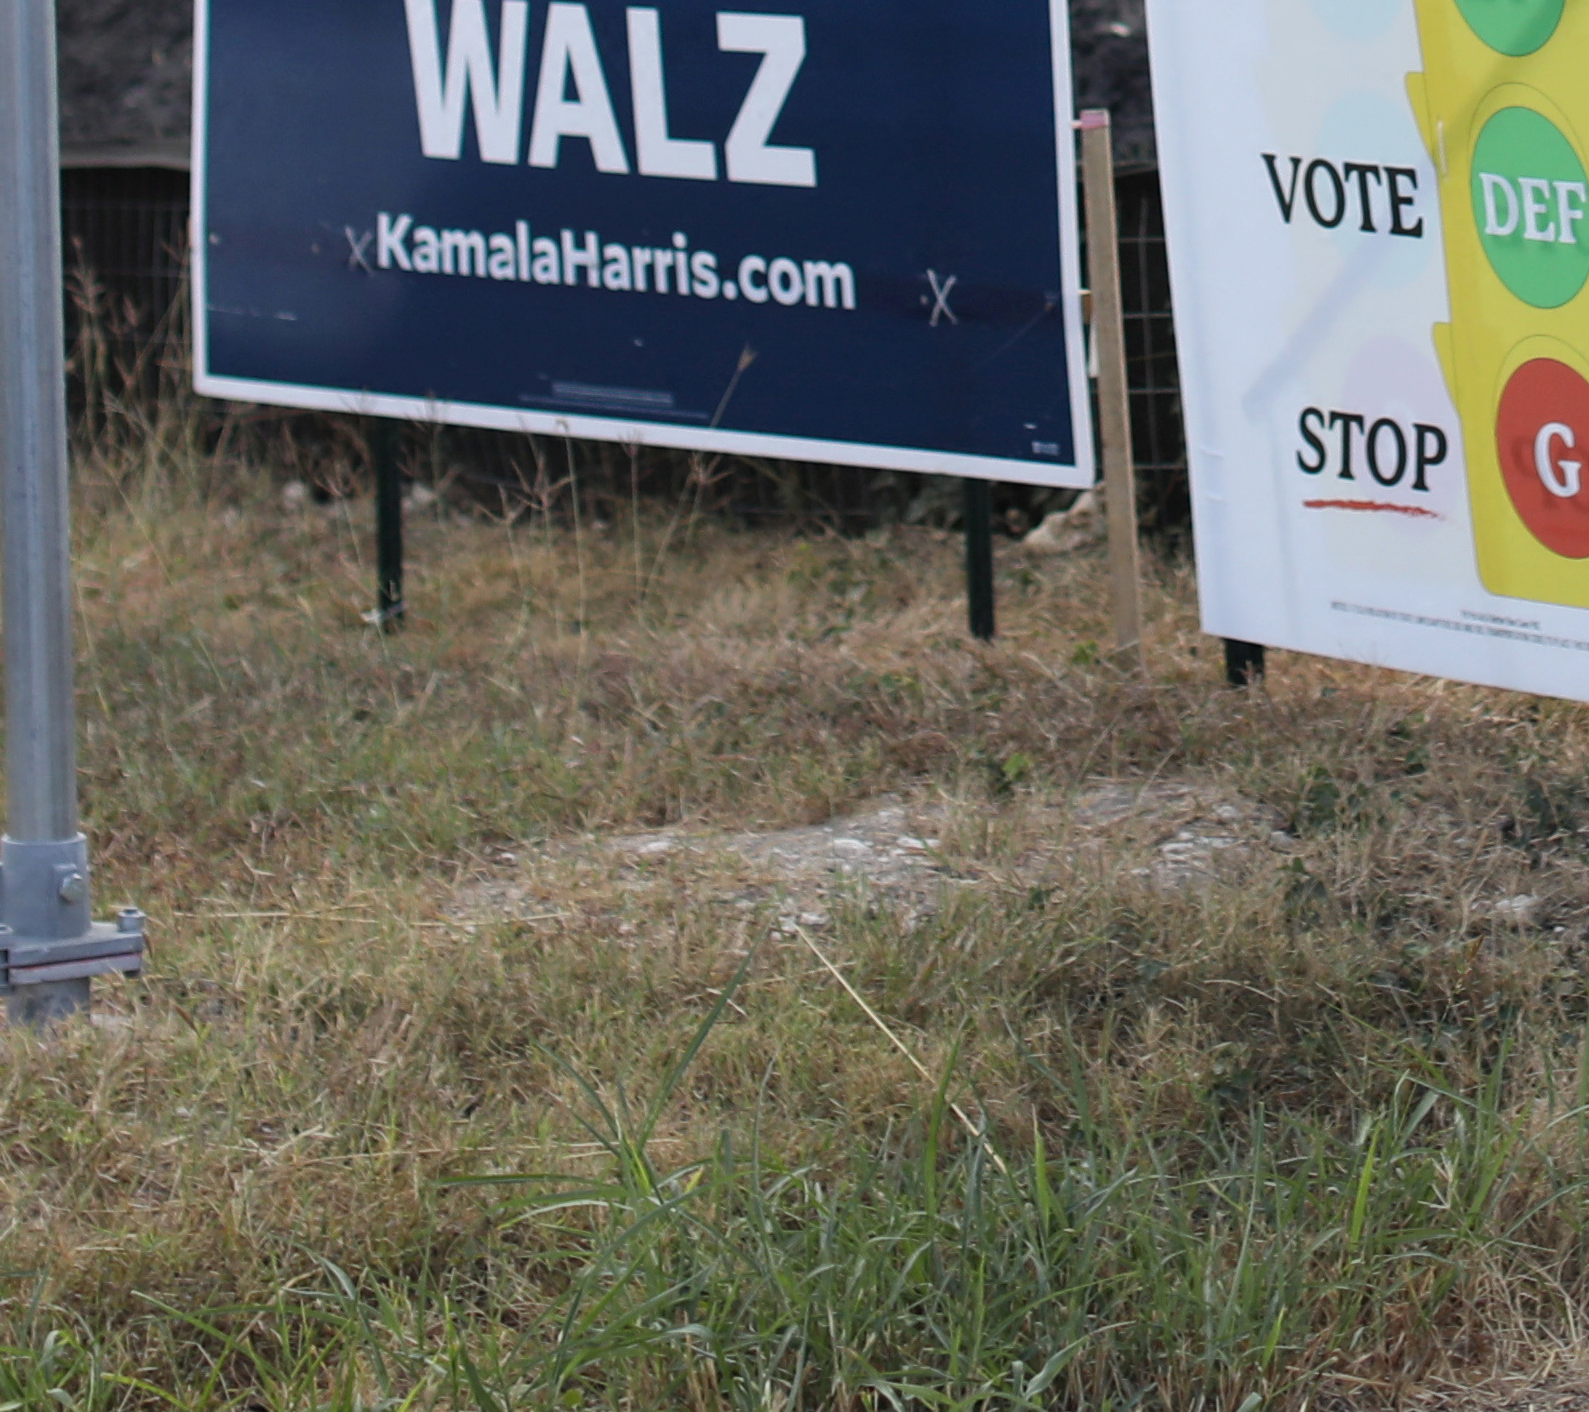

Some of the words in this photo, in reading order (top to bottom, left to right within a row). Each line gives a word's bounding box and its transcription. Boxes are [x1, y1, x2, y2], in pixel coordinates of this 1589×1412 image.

[1261, 153, 1424, 239] VOTE
[1478, 171, 1587, 246] DEF
[376, 211, 856, 310] KamalaHarris.com
[1296, 406, 1448, 492] STOP
[1533, 422, 1582, 498] G
